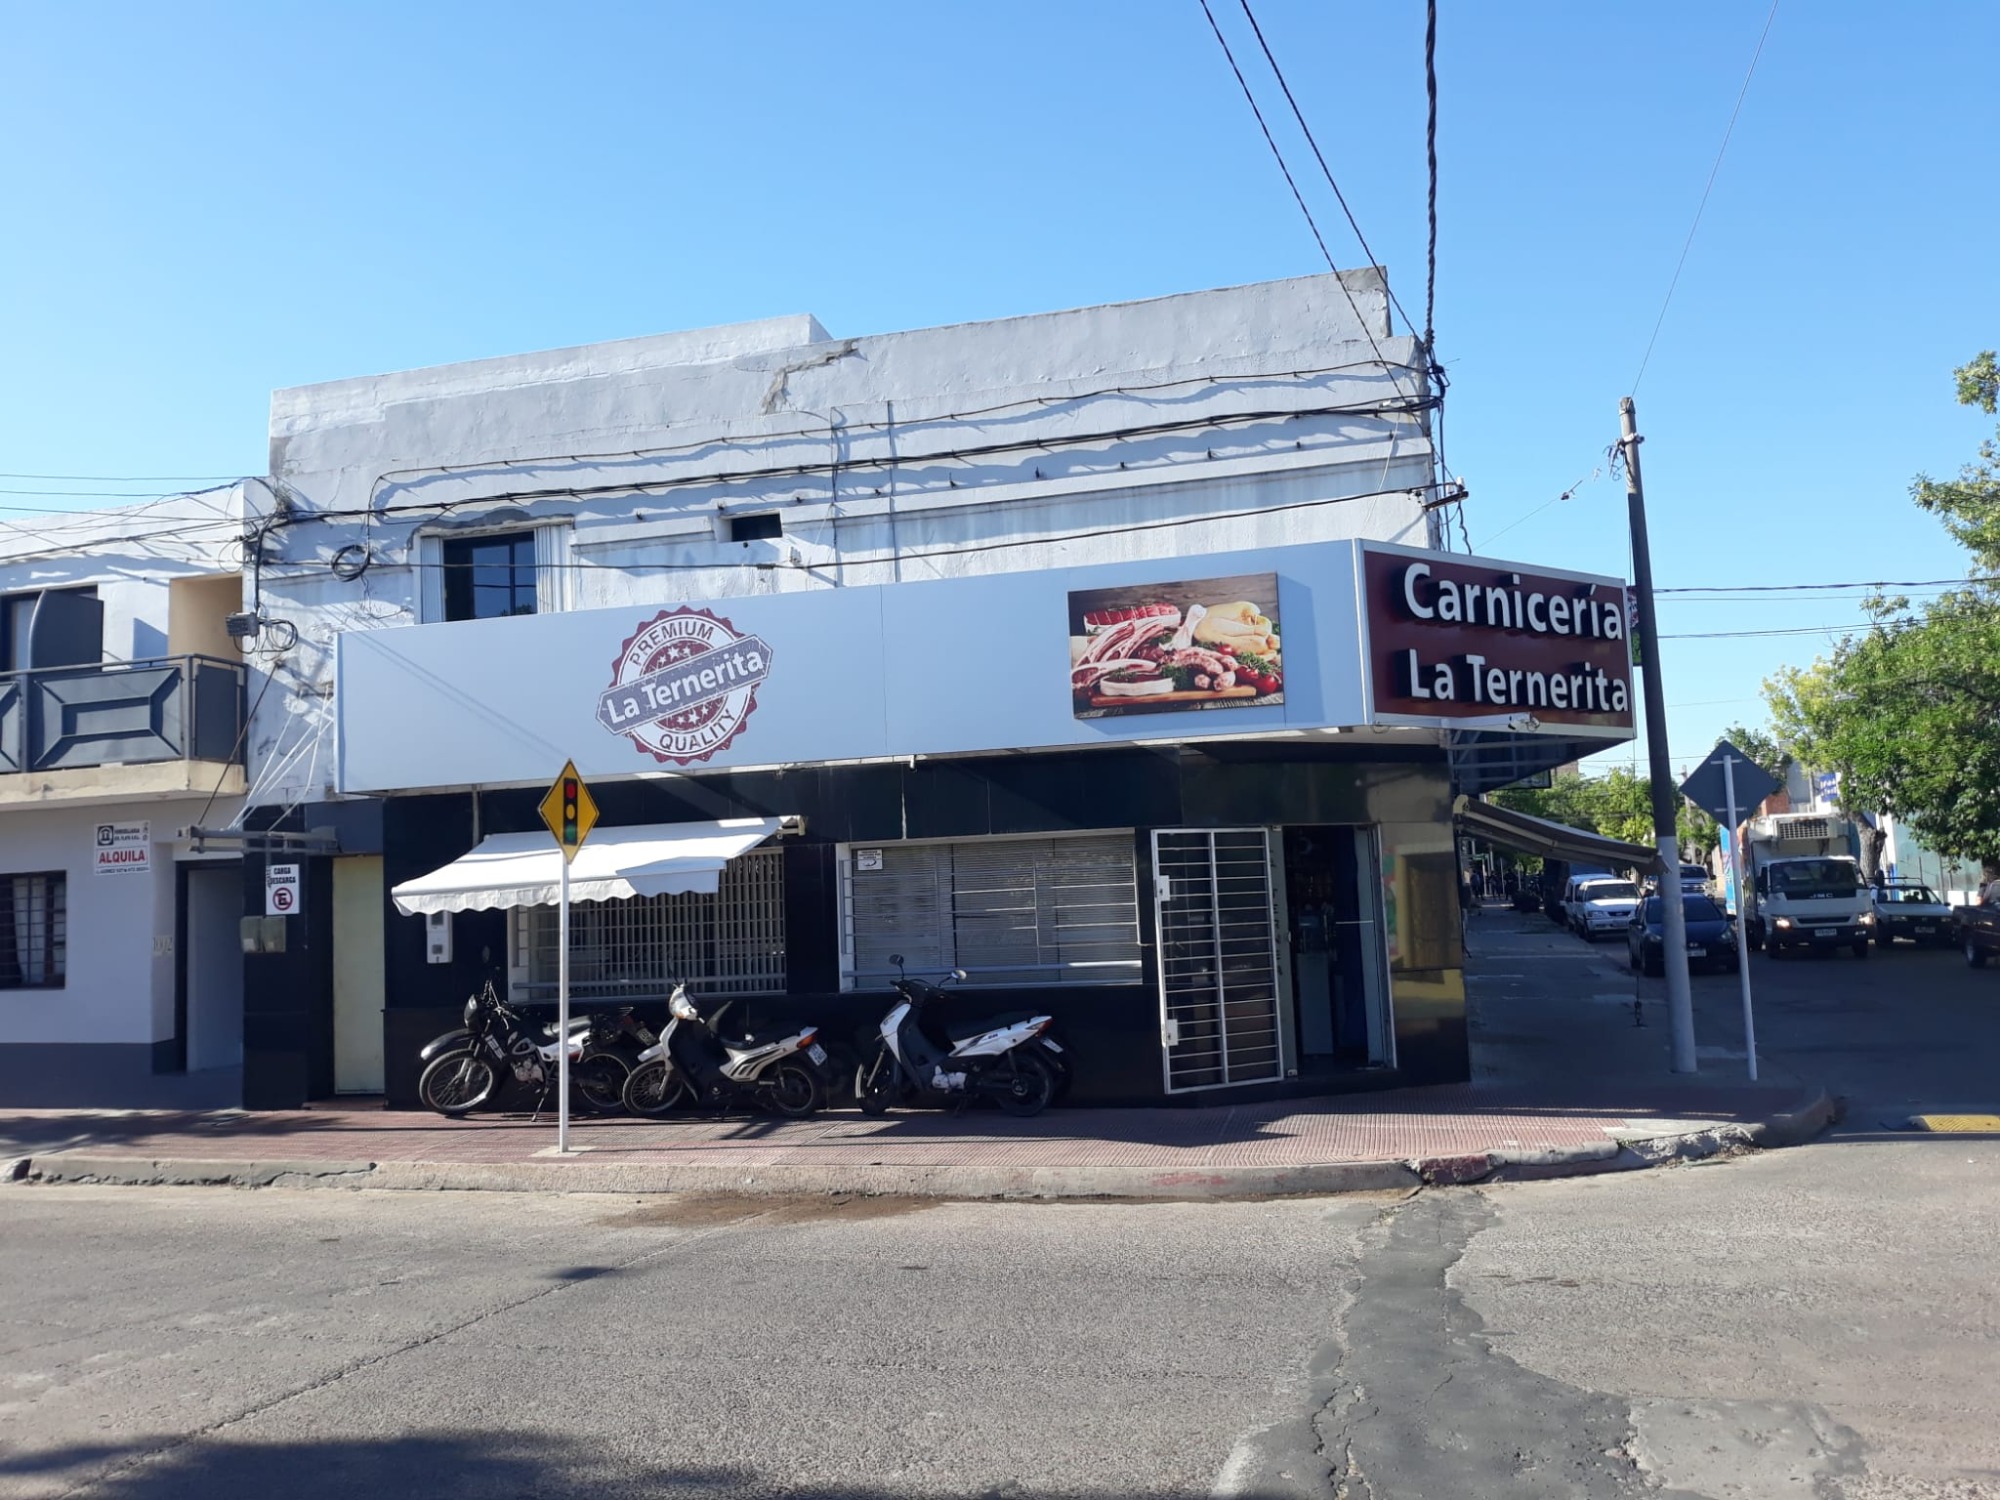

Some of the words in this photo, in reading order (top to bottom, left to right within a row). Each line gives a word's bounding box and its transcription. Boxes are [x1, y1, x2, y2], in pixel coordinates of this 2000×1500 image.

[1404, 562, 1623, 640] Carnicería
[629, 620, 715, 666] PREMIUM
[606, 696, 641, 724] La
[641, 651, 764, 711] Ternerita
[1409, 648, 1455, 700] La
[1466, 654, 1629, 712] Ternerita
[659, 708, 736, 751] QUALITY
[98, 850, 146, 864] ALQUILA
[273, 866, 292, 875] CARGA
